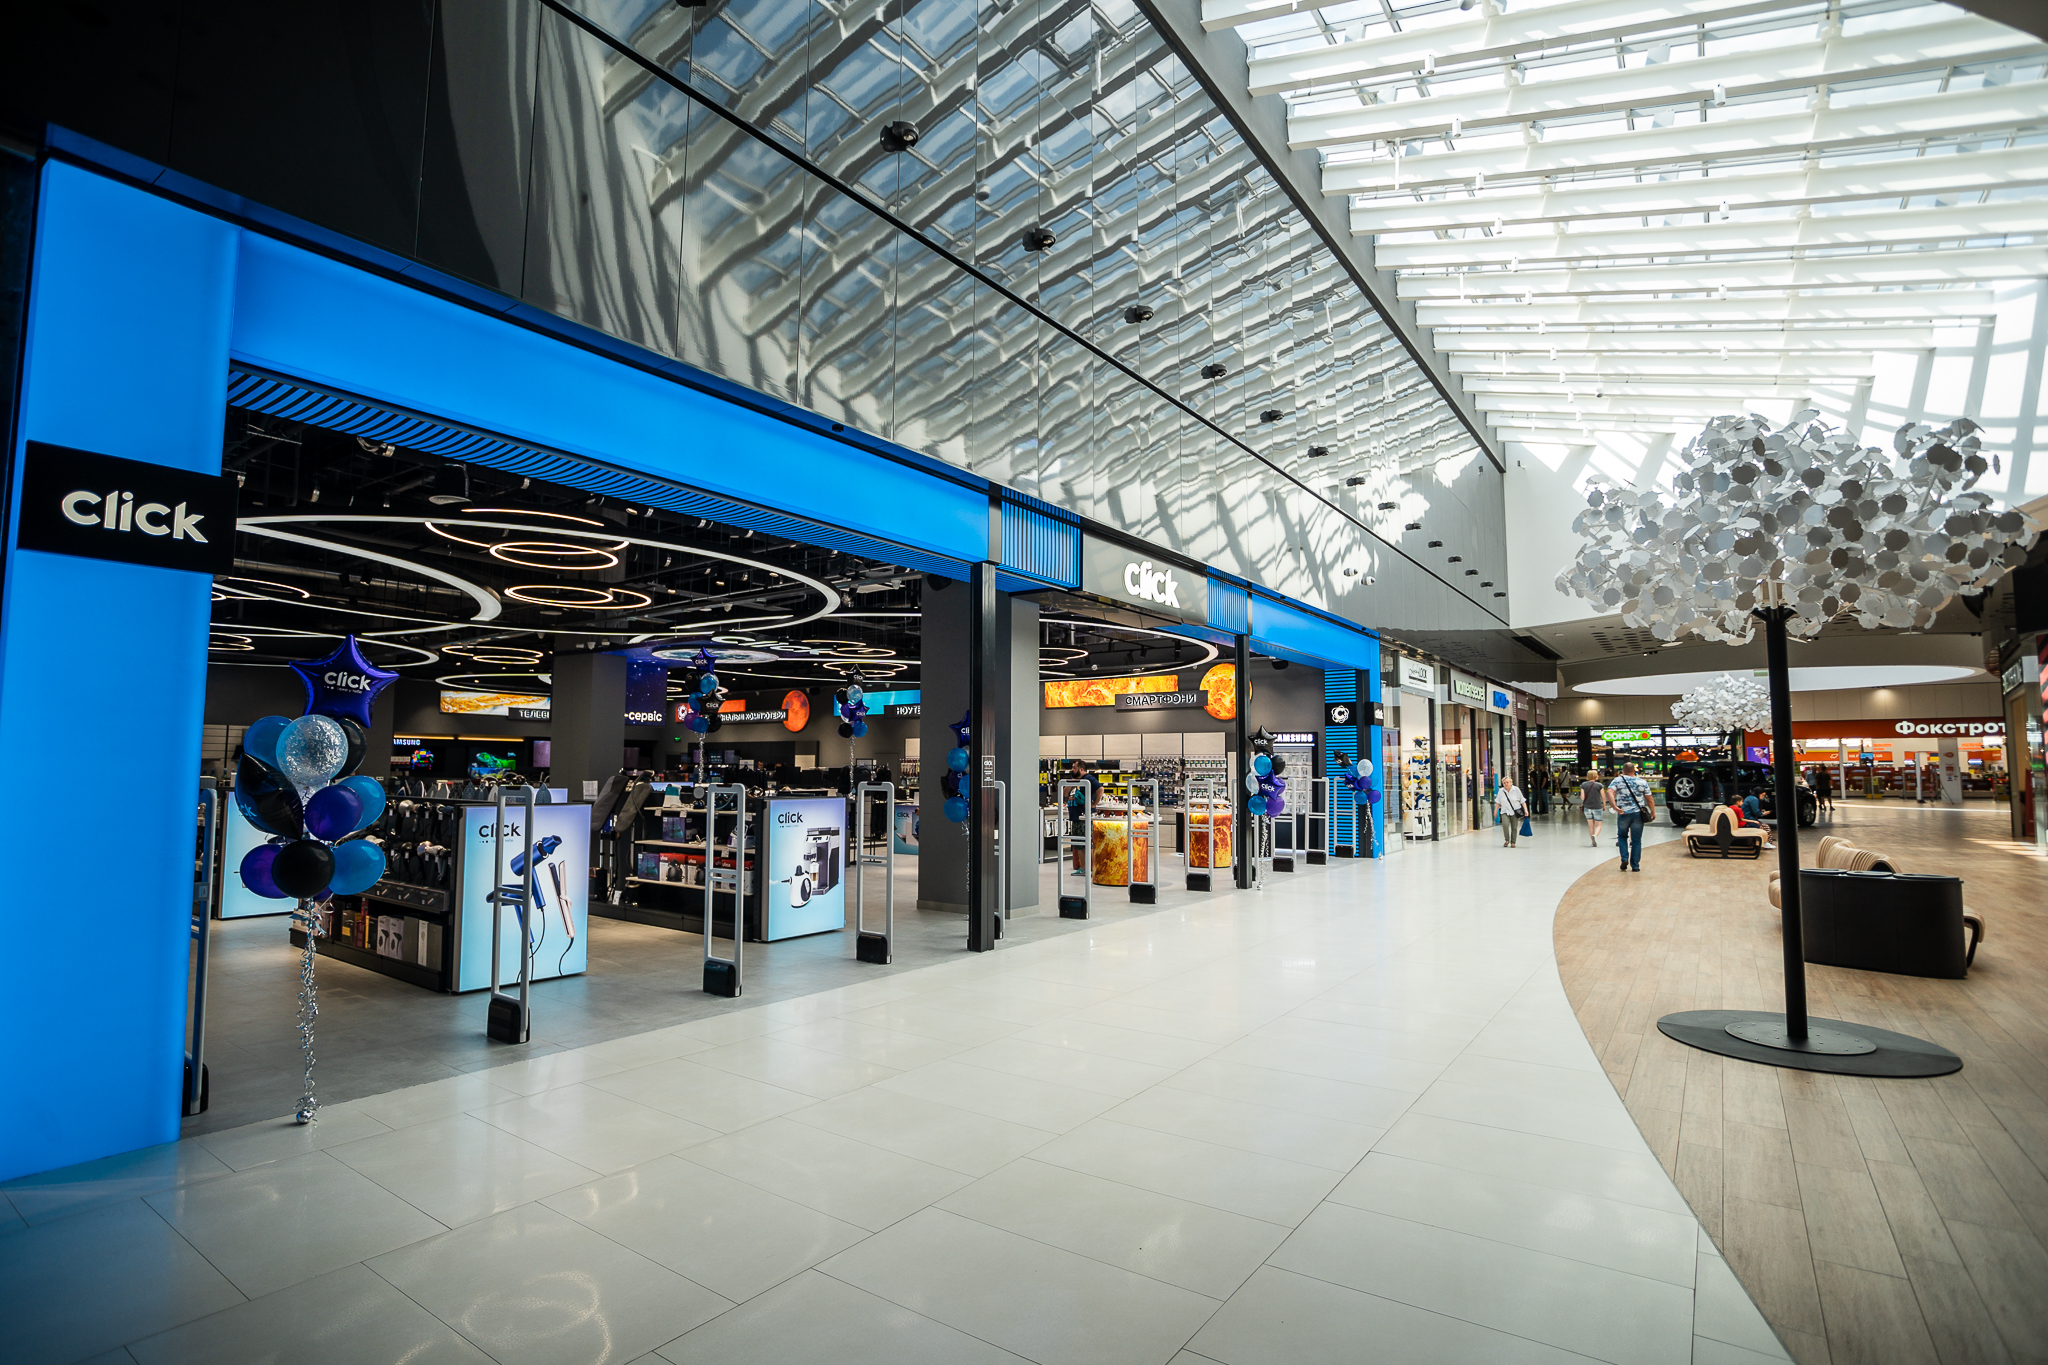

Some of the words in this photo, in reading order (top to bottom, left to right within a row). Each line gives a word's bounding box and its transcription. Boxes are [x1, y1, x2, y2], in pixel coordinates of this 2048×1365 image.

[61, 490, 209, 544] click
[1123, 560, 1181, 609] click
[324, 671, 371, 691] click
[1125, 693, 1197, 706] СМАРТФОНИ
[1603, 732, 1642, 740] COMFY
[1261, 783, 1275, 792] click
[777, 811, 804, 824] click
